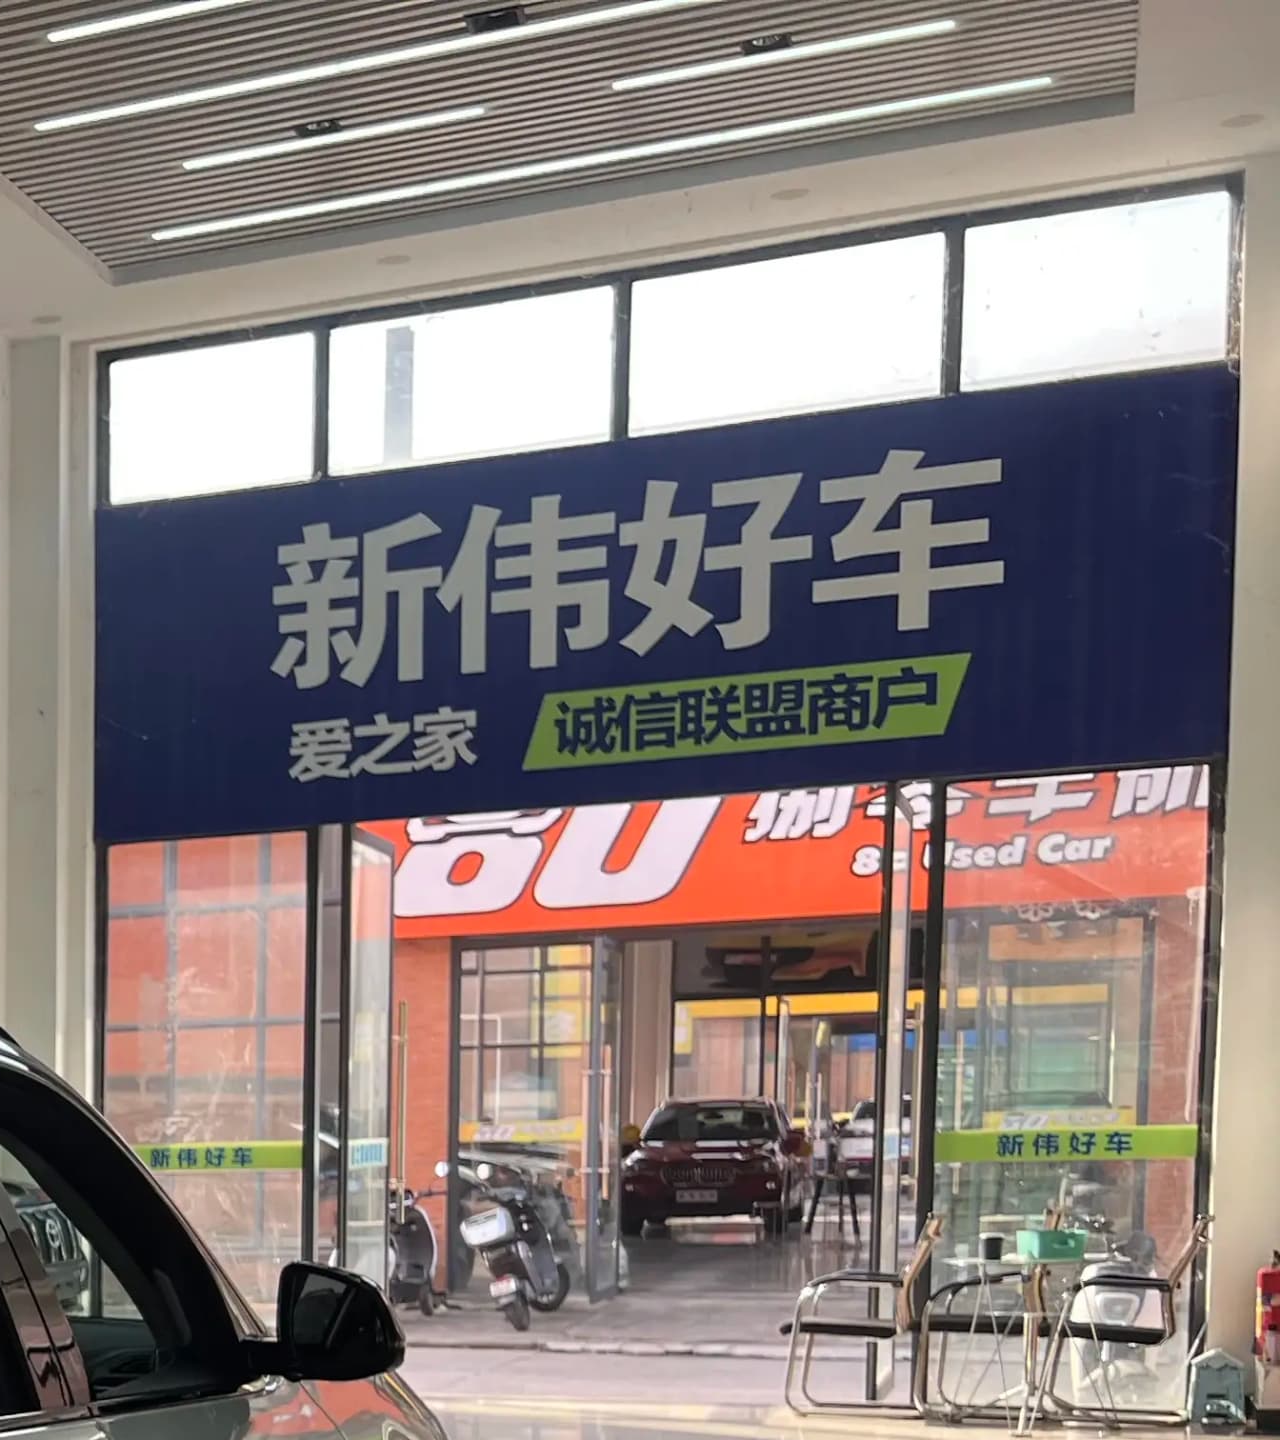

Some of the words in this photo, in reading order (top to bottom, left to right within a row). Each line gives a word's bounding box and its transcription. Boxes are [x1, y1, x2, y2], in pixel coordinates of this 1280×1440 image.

[270, 450, 1004, 689] 新伟好车
[554, 666, 938, 757] 诚信联盟商户
[288, 707, 478, 782] 爱之家
[1035, 831, 1115, 866] Car
[149, 1146, 253, 1168] 新伟好车
[996, 1130, 1133, 1157] 新伟好车
